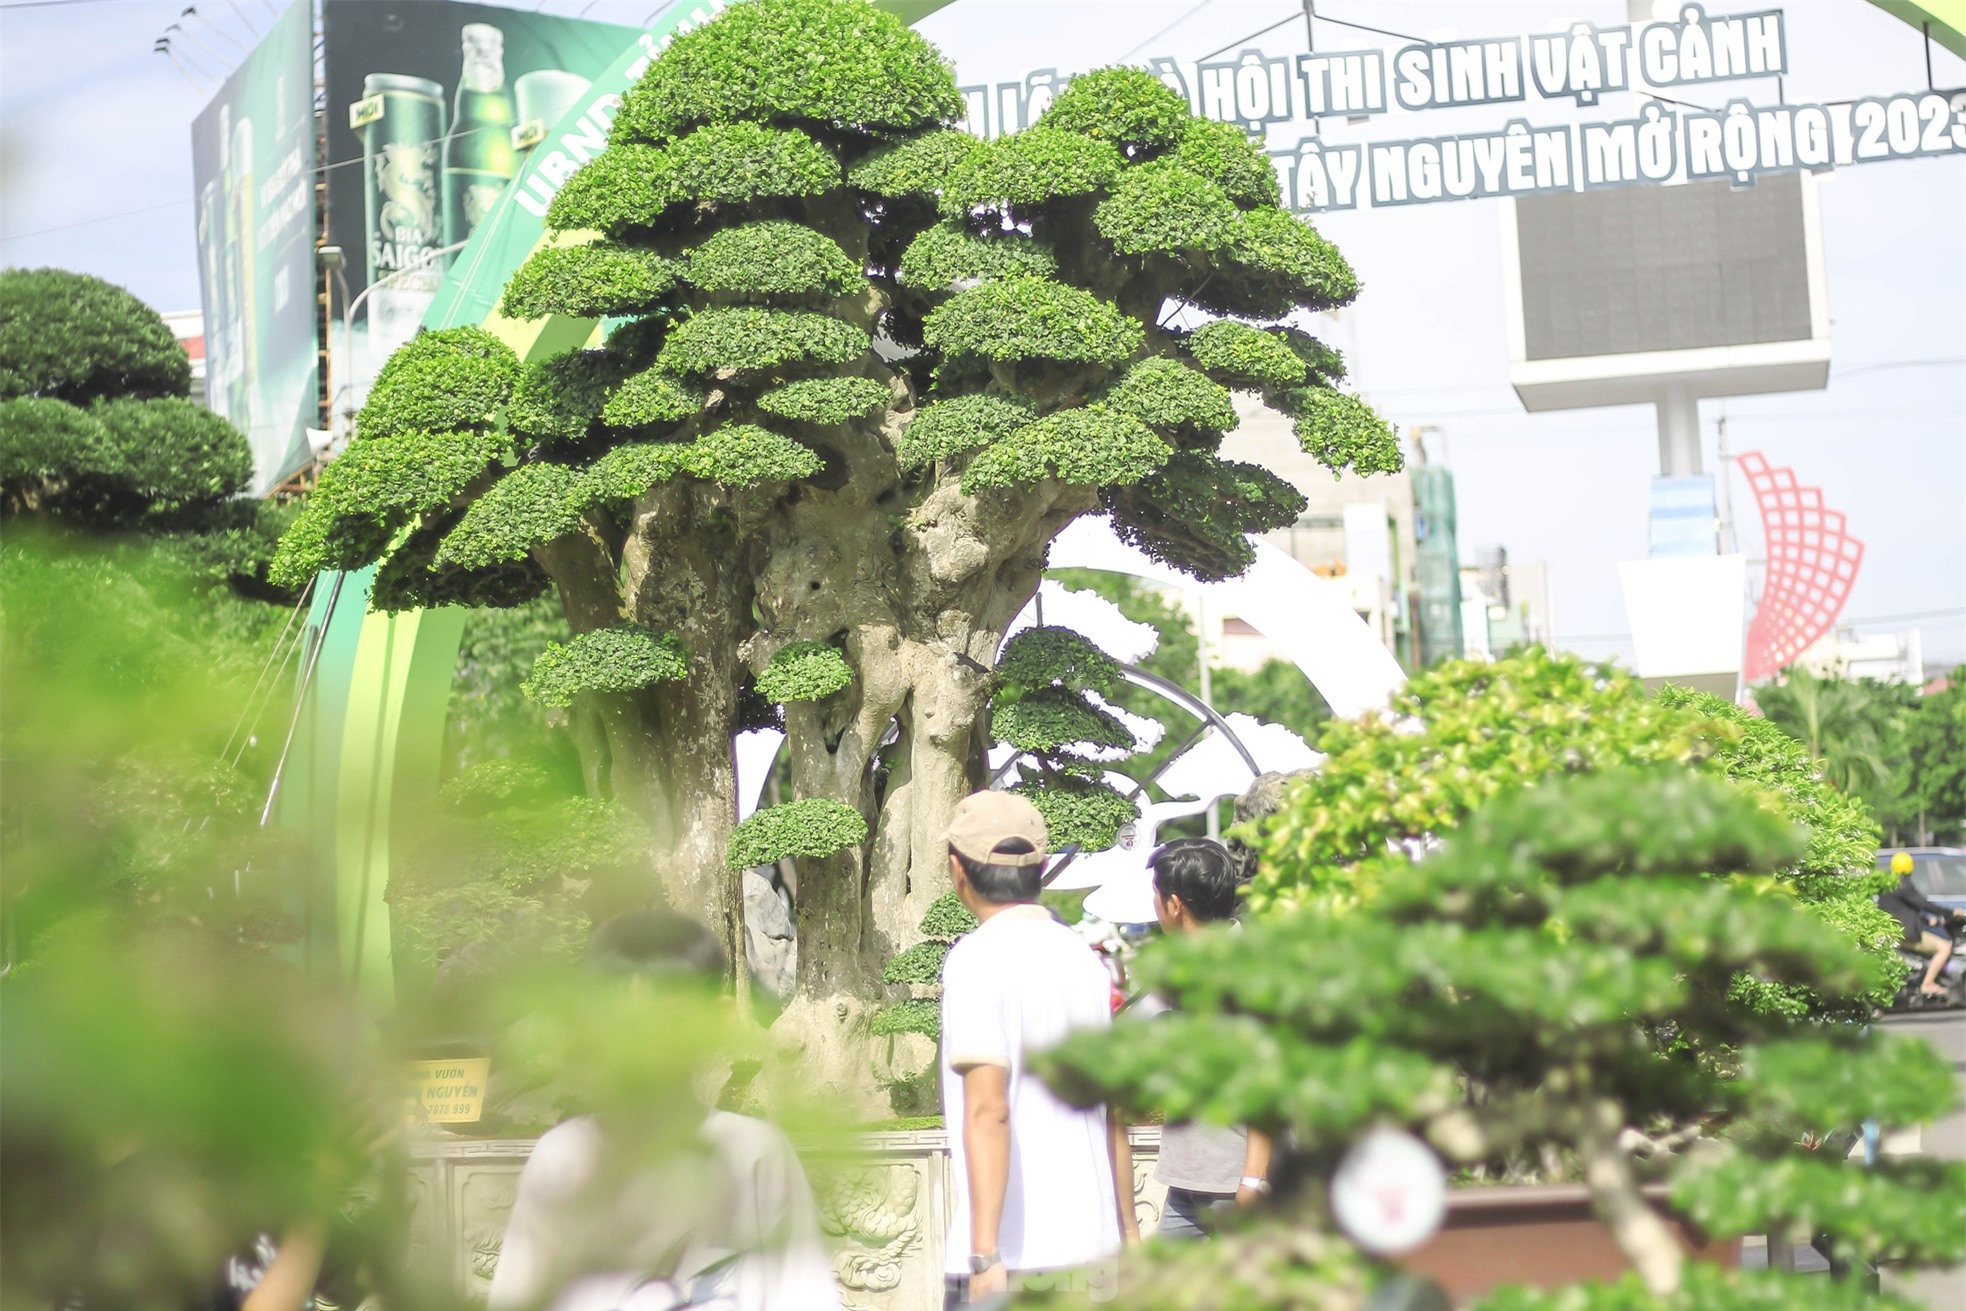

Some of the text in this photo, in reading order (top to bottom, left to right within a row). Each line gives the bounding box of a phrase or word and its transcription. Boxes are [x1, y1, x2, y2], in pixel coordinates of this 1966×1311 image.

[1202, 54, 1288, 131] HỘI
[1302, 54, 1382, 116] THI
[1399, 42, 1520, 107] SINH
[1533, 24, 1627, 102] VẬT
[1643, 7, 1782, 84] CẢNH
[514, 93, 622, 217] UBND
[1373, 127, 1570, 201] NGUYÊN
[1585, 104, 1677, 184] MỞ
[1689, 102, 1829, 182] RỘNG
[395, 226, 423, 244] BIA
